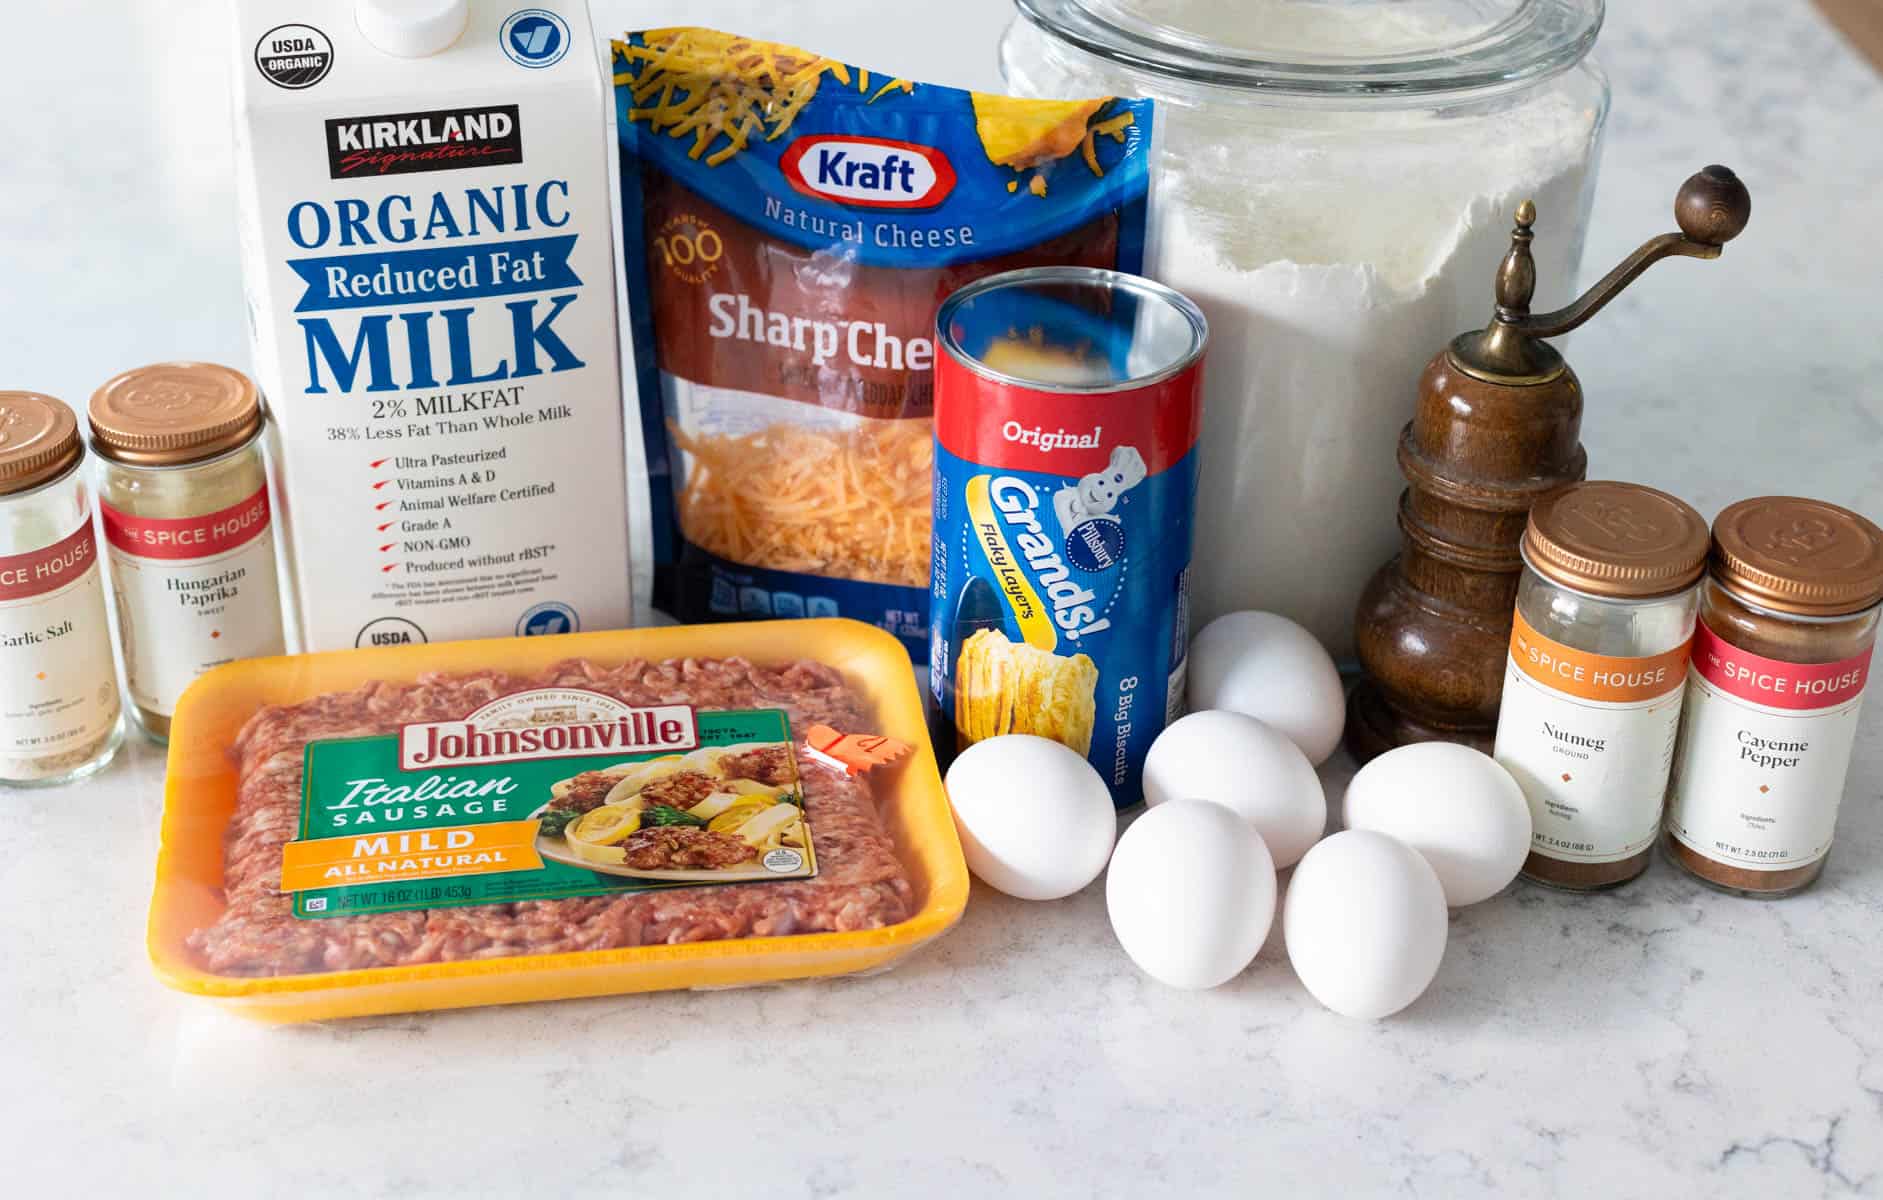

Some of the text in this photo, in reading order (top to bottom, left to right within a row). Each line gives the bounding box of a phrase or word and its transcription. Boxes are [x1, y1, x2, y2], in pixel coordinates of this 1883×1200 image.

[272, 38, 316, 54] USDA
[267, 55, 323, 71] ORGANIC
[336, 112, 513, 152] KIRKLAND
[340, 146, 513, 173] Signature
[817, 148, 915, 194] Kraft
[287, 180, 570, 249] ORGANIC
[764, 197, 975, 249] Natural Cheese
[654, 229, 723, 266] 100
[325, 250, 546, 299] Reduced Fat
[296, 293, 586, 394] MILK
[709, 293, 934, 371] Sharp Che
[372, 385, 525, 419] 2% MILKFAT
[327, 405, 573, 441] 38% Less Fat Than Whole Milk
[1002, 421, 1102, 452] Original
[395, 447, 507, 470] Ultra Pasteurized
[397, 469, 496, 491] Vitamins A & D
[399, 482, 556, 512] Animal Welfare Certified
[144, 528, 207, 545] SPICE
[213, 500, 265, 539] HOUSE
[401, 517, 452, 533] Grade A
[35, 538, 89, 579] HOUSE
[403, 535, 471, 553] NON-GMO
[990, 476, 1111, 641] Grands!
[1076, 520, 1115, 569] Pillsbury
[405, 555, 465, 574] Produced
[468, 551, 516, 567] without
[981, 523, 1035, 620] Flaky Layers
[167, 567, 246, 591] Hungarian
[180, 586, 239, 607] Paprika
[46, 620, 73, 640] Salt
[371, 631, 412, 646] USDA
[1528, 647, 1585, 681] SPICE
[1593, 666, 1667, 688] HOUSE
[1724, 661, 1787, 693] SPICE
[1795, 669, 1861, 696] HOUSE
[517, 693, 558, 705] OWNED
[561, 693, 592, 703] SINCE
[413, 710, 683, 765] Johnsonville
[1114, 675, 1139, 786] 8 Big Biscuits
[1541, 721, 1606, 752] Nutmeg
[1737, 729, 1809, 751] Cayenne
[1552, 745, 1590, 760] GROUND
[1741, 745, 1801, 769] Pepper
[326, 775, 519, 811] Italian
[332, 799, 508, 827] SAUSAGE
[352, 830, 476, 858] MILD
[324, 862, 374, 879] ALL
[377, 851, 508, 873] NATURAL
[361, 891, 378, 905] WT
[382, 890, 396, 903] 16
